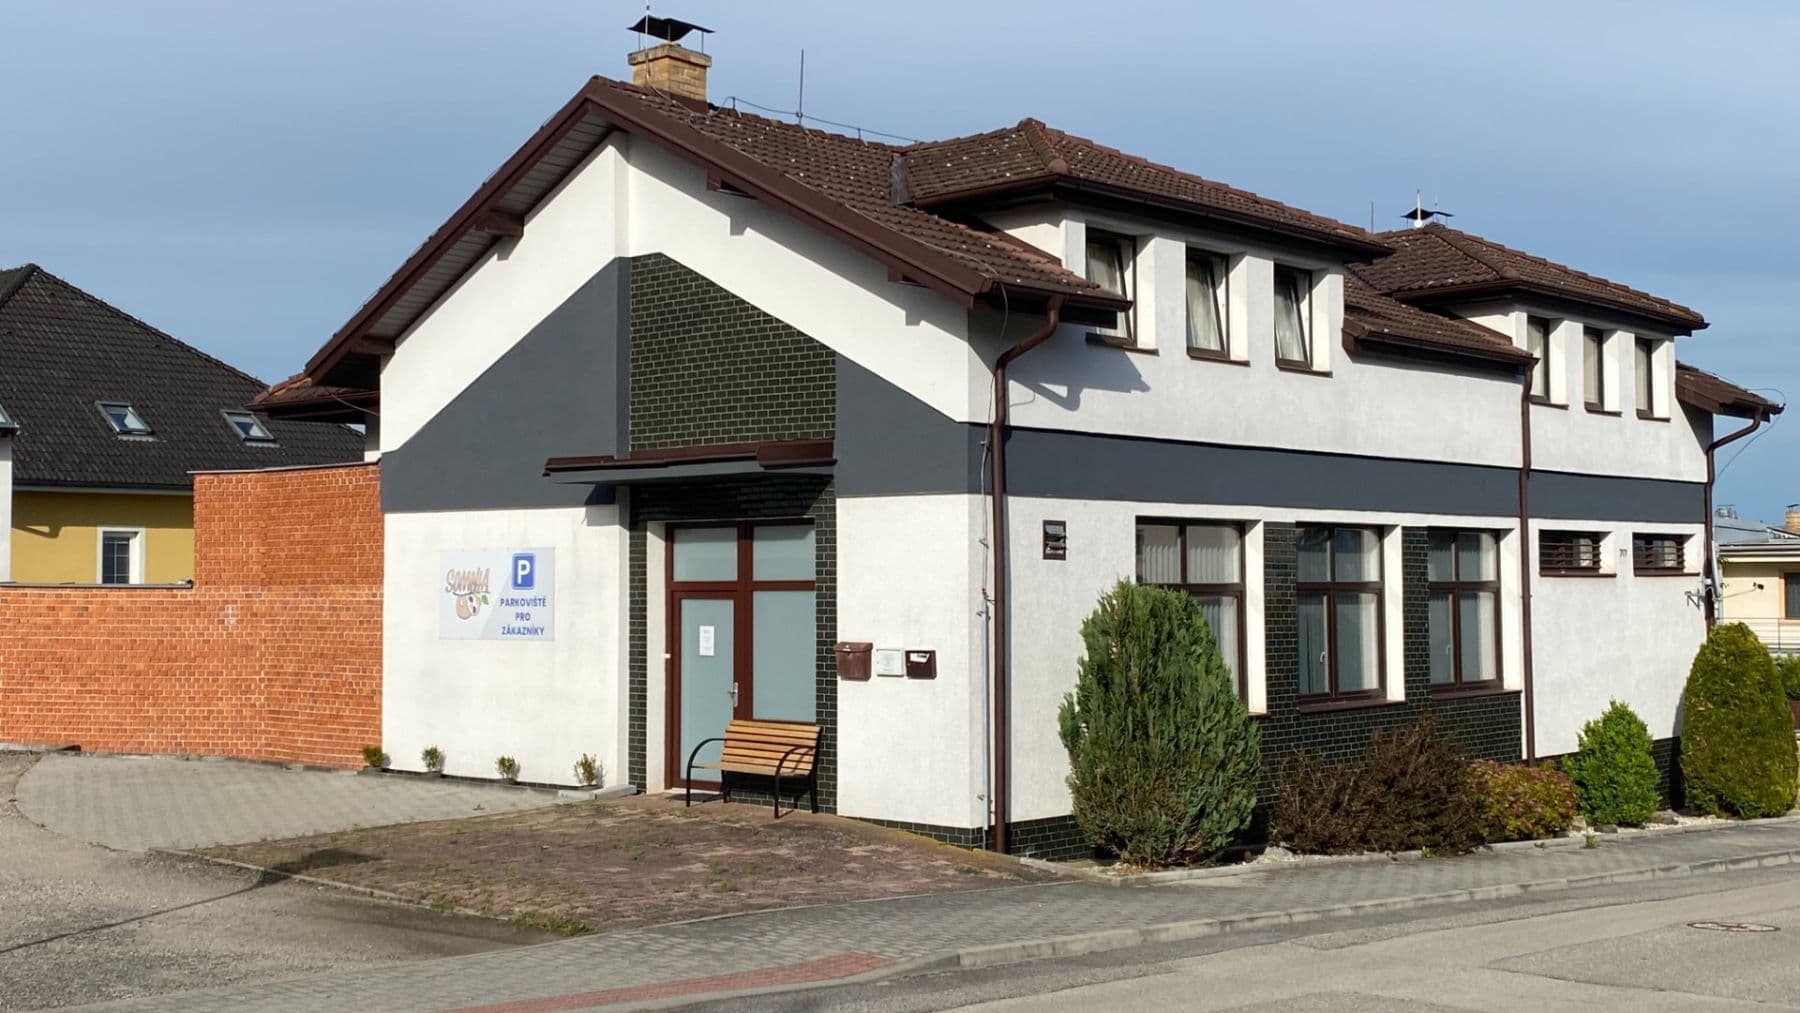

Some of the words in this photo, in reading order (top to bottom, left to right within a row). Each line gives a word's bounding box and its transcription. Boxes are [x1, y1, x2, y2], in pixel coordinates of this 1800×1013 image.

[517, 559, 531, 585] P
[515, 612, 531, 621] PRO
[501, 624, 545, 635] ZÁKAZNÍKY
